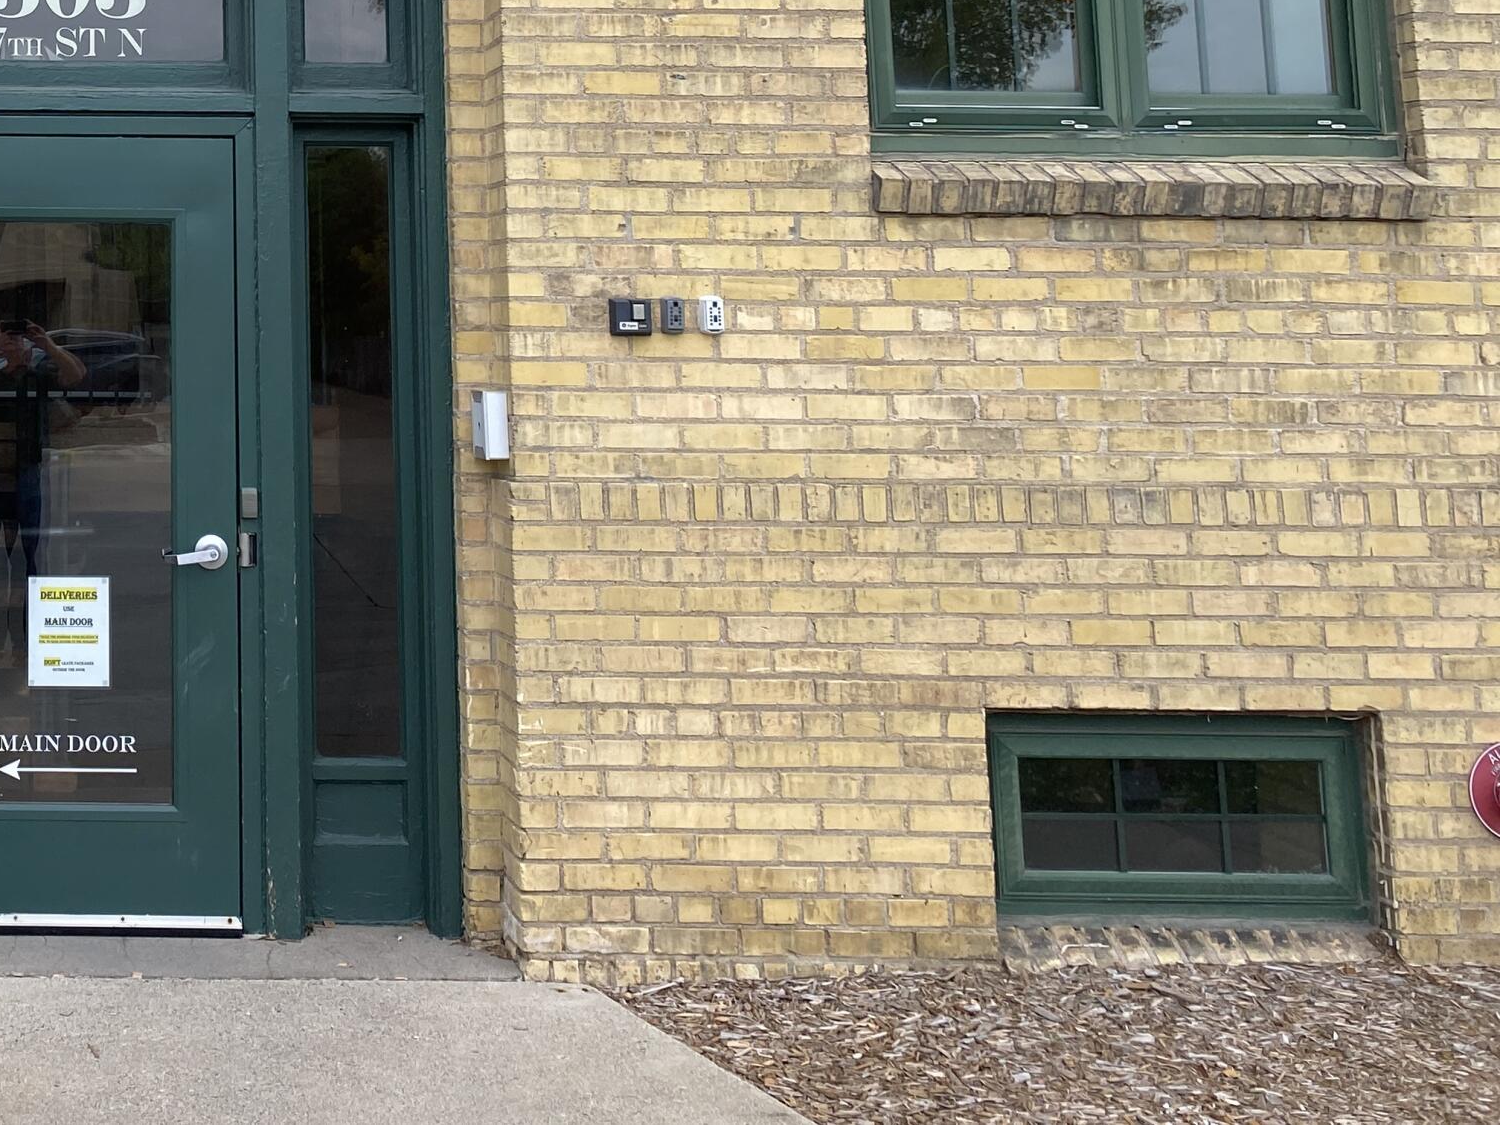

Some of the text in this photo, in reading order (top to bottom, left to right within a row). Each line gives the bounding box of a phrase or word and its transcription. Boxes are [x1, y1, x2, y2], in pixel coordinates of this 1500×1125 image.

[55, 26, 106, 57] ST
[117, 28, 147, 58] N
[40, 590, 98, 600] DELIVERIES
[44, 617, 94, 627] MAIN DOOR
[66, 735, 137, 753] DOOR
